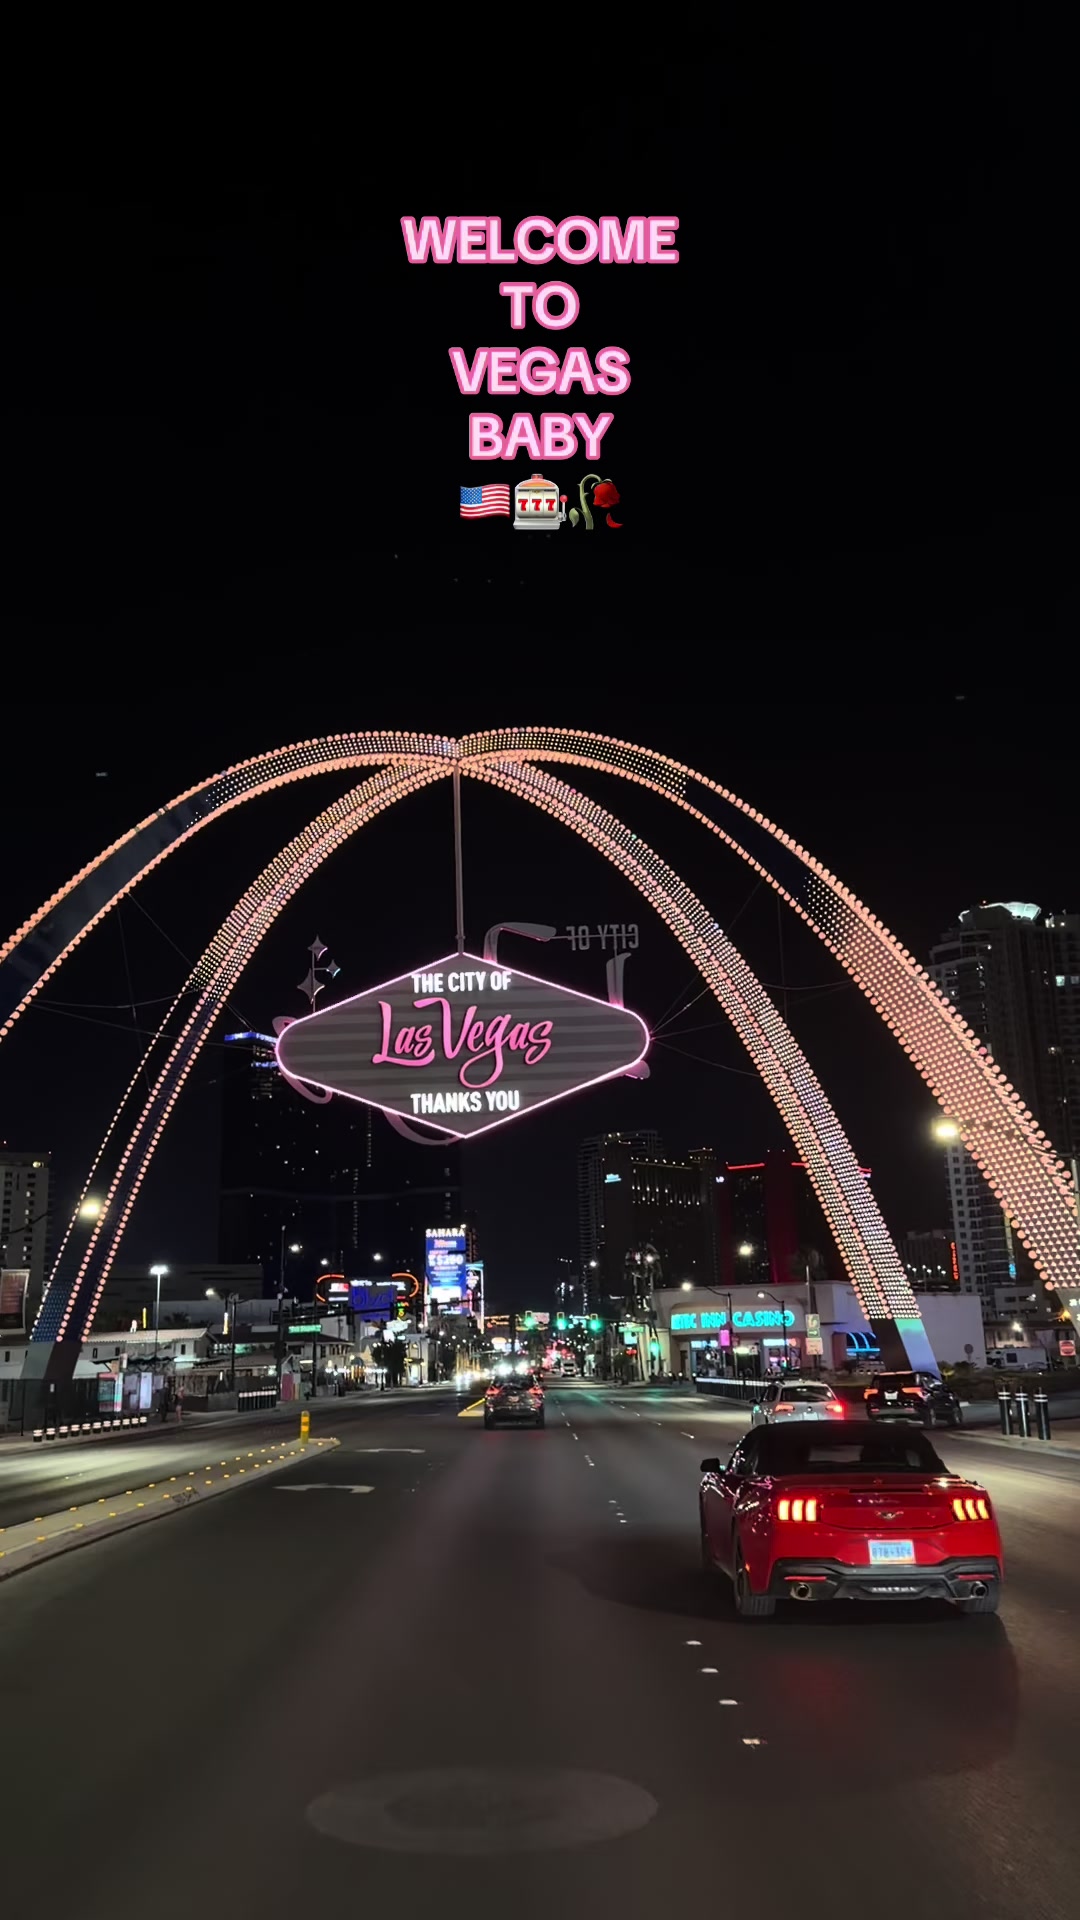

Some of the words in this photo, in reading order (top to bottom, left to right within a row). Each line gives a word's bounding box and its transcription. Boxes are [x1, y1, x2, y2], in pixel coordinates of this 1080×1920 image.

[411, 973, 443, 993] THE
[448, 971, 486, 991] CITY
[490, 971, 511, 990] OF
[372, 1000, 435, 1067] Las
[413, 997, 553, 1088] Vegas
[410, 1092, 482, 1114] THANKS
[484, 1090, 520, 1111] YOU
[426, 1228, 465, 1238] SAHARA
[701, 1311, 727, 1328] INN
[732, 1310, 795, 1327] CASINO
